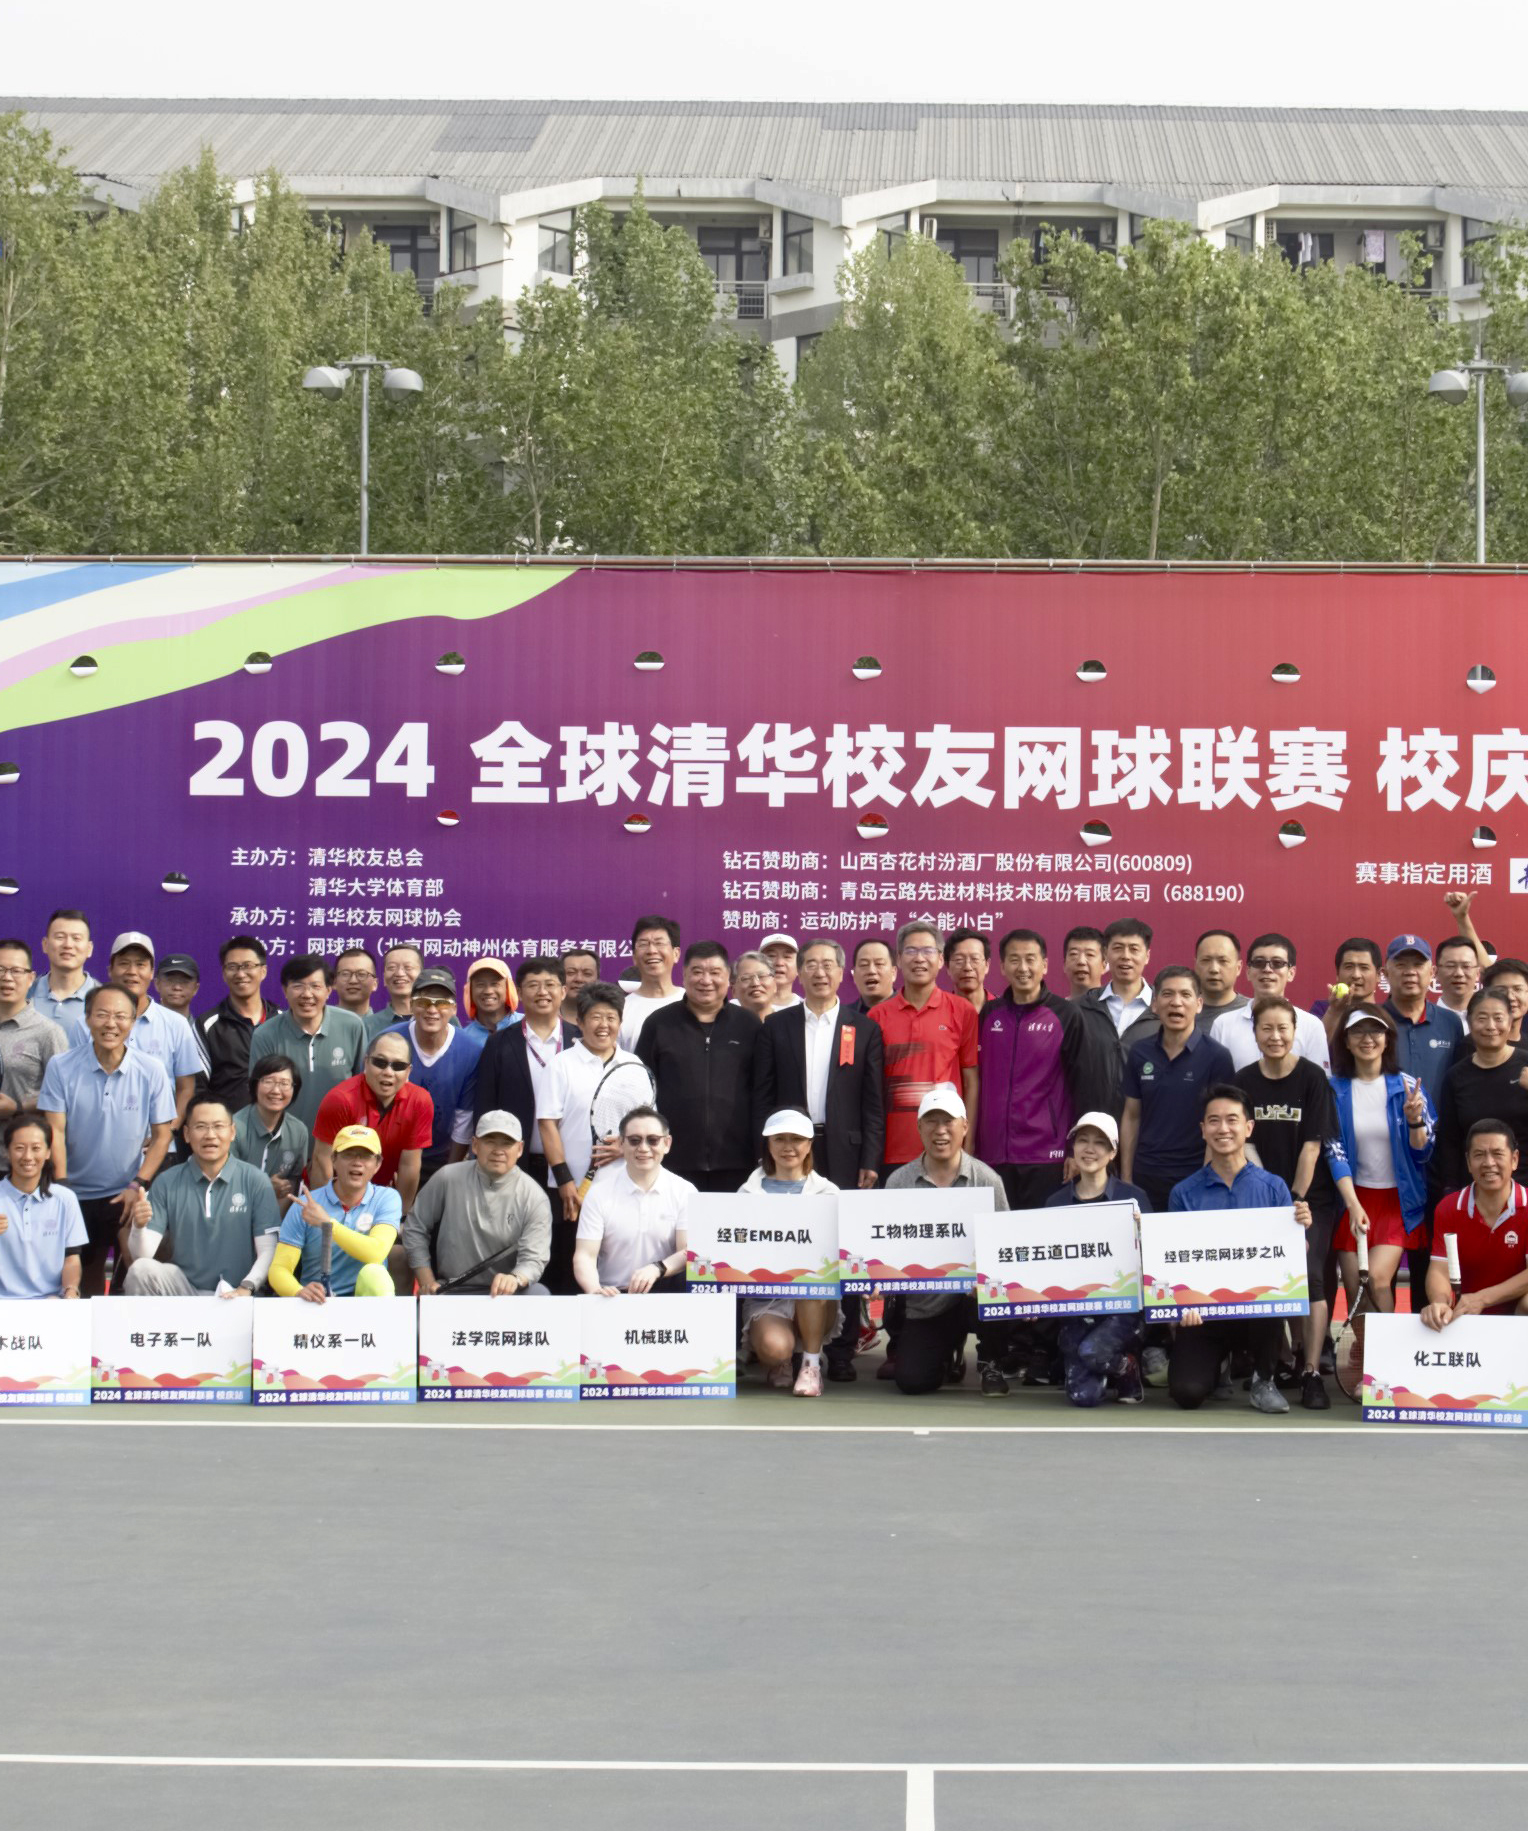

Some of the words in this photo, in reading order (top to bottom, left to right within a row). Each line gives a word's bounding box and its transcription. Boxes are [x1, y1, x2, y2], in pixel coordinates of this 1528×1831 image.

[189, 719, 435, 798] 2024
[470, 720, 1351, 812] 全球清华校友网球联赛
[230, 847, 424, 868] 主办方：清华校友总会
[722, 851, 1193, 874] 钻石赞助商：山西杏花村汾酒厂股份有限公司(600809)
[1355, 861, 1492, 886] 赛事指定用酒
[309, 877, 444, 898] 清华大学体育部
[229, 907, 462, 927] 承办方：清华校友网球协会
[717, 1227, 812, 1245] 经管EMBA队
[871, 1222, 967, 1239] 工物物理系队
[998, 1241, 1113, 1263] 经管五道口联队
[1164, 1245, 1286, 1264] 经管学院网球梦之队
[691, 1284, 718, 1294] 2024
[844, 1283, 871, 1292] 2024
[984, 1306, 1011, 1316] 2024
[1150, 1308, 1178, 1319] 2024
[130, 1331, 212, 1348] 电子系一队
[293, 1332, 376, 1349] 精仪系一队
[452, 1330, 550, 1347] 法学院网球队
[624, 1328, 689, 1345] 机械联队
[1413, 1351, 1482, 1368] 化工联队
[93, 1390, 121, 1401] 2024
[258, 1392, 286, 1403] 2024
[424, 1389, 452, 1399] 2024
[582, 1387, 610, 1397] 2024
[1367, 1410, 1396, 1421] 2024
